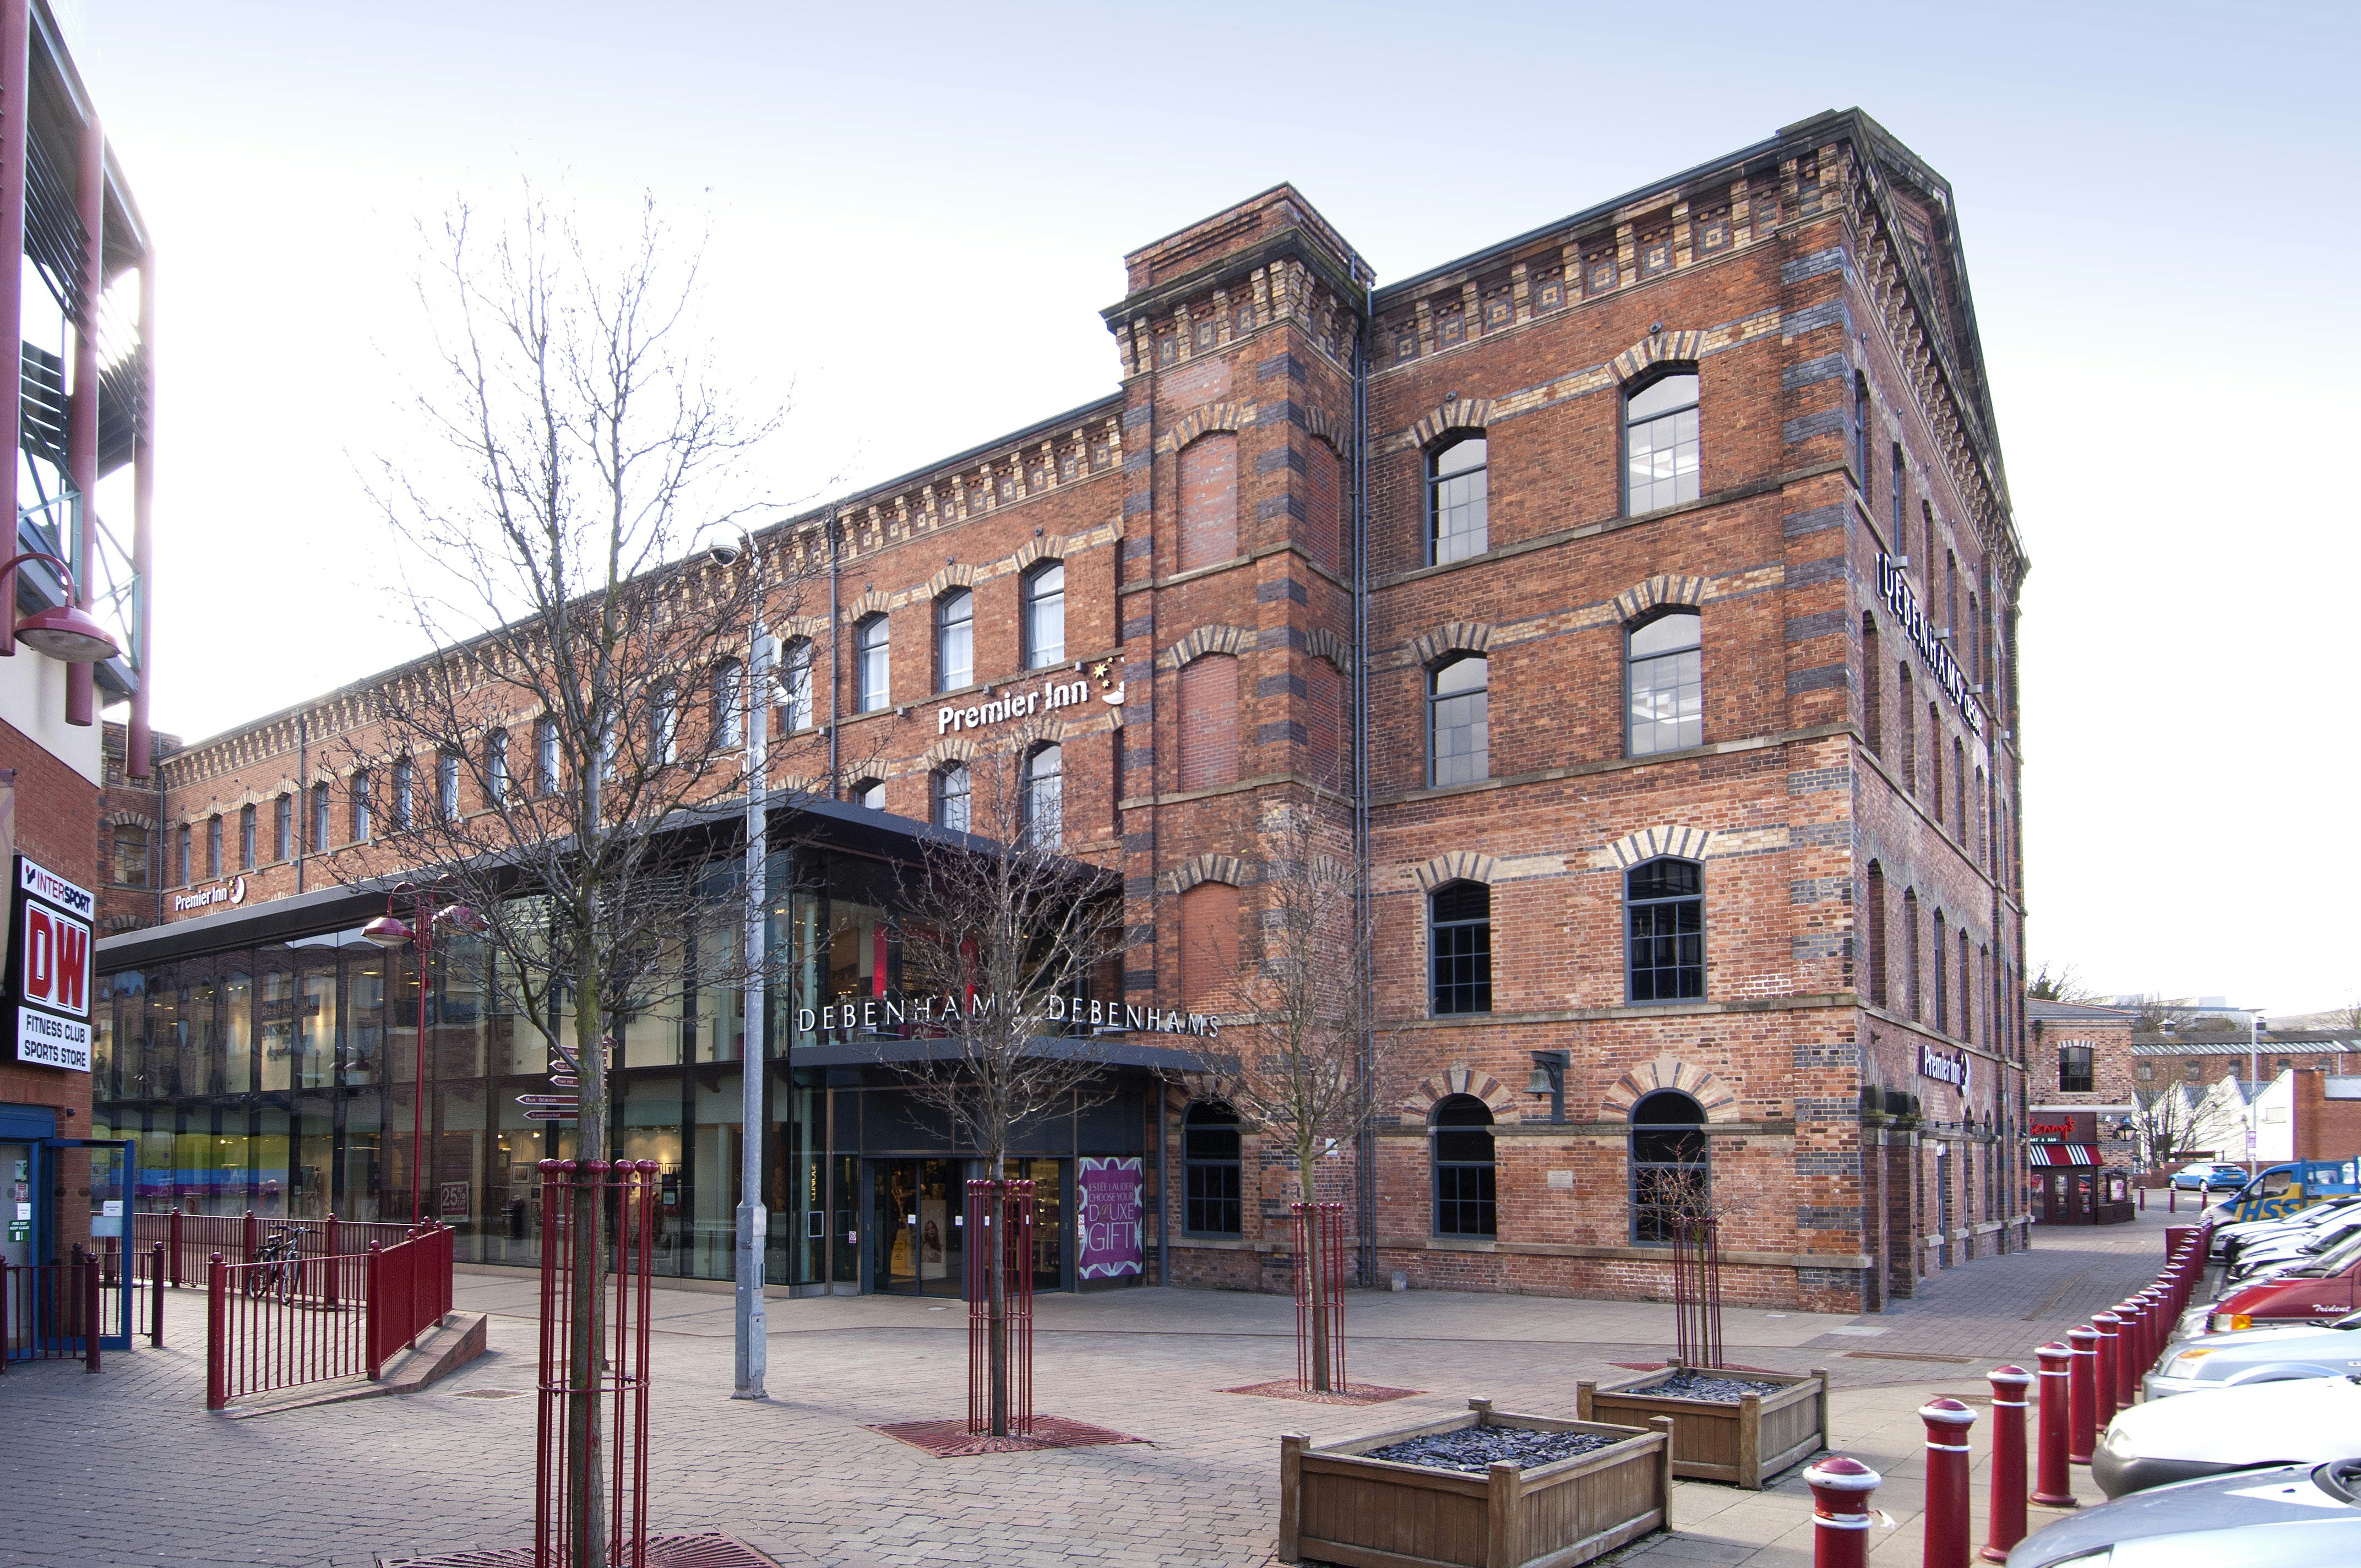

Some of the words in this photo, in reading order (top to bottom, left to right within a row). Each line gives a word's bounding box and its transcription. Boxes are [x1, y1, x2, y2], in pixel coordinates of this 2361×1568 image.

[1880, 552, 1962, 705] DEBENHAMS
[939, 692, 1039, 734] Premier
[1045, 680, 1088, 710] Inn
[37, 871, 90, 913] INTERSPORT
[175, 890, 211, 911] Premier
[211, 887, 227, 902] Inn
[28, 905, 88, 1012] DW
[26, 1014, 62, 1038] FITNESS
[65, 1024, 85, 1043] CLUB
[1048, 994, 1218, 1038] DEBENHAMS
[25, 1039, 59, 1062] SPORTS
[62, 1047, 86, 1067] STORE
[1924, 1045, 1950, 1081] Premier
[1951, 1055, 1960, 1085] Inn
[1089, 1193, 1116, 1202] CHOOSE
[1117, 1193, 1134, 1201] YOUR
[1108, 1182, 1134, 1191] LAUDER
[2240, 1198, 2301, 1223] HSS
[1089, 1221, 1134, 1251] GIFT
[2312, 1304, 2351, 1312] Trident
